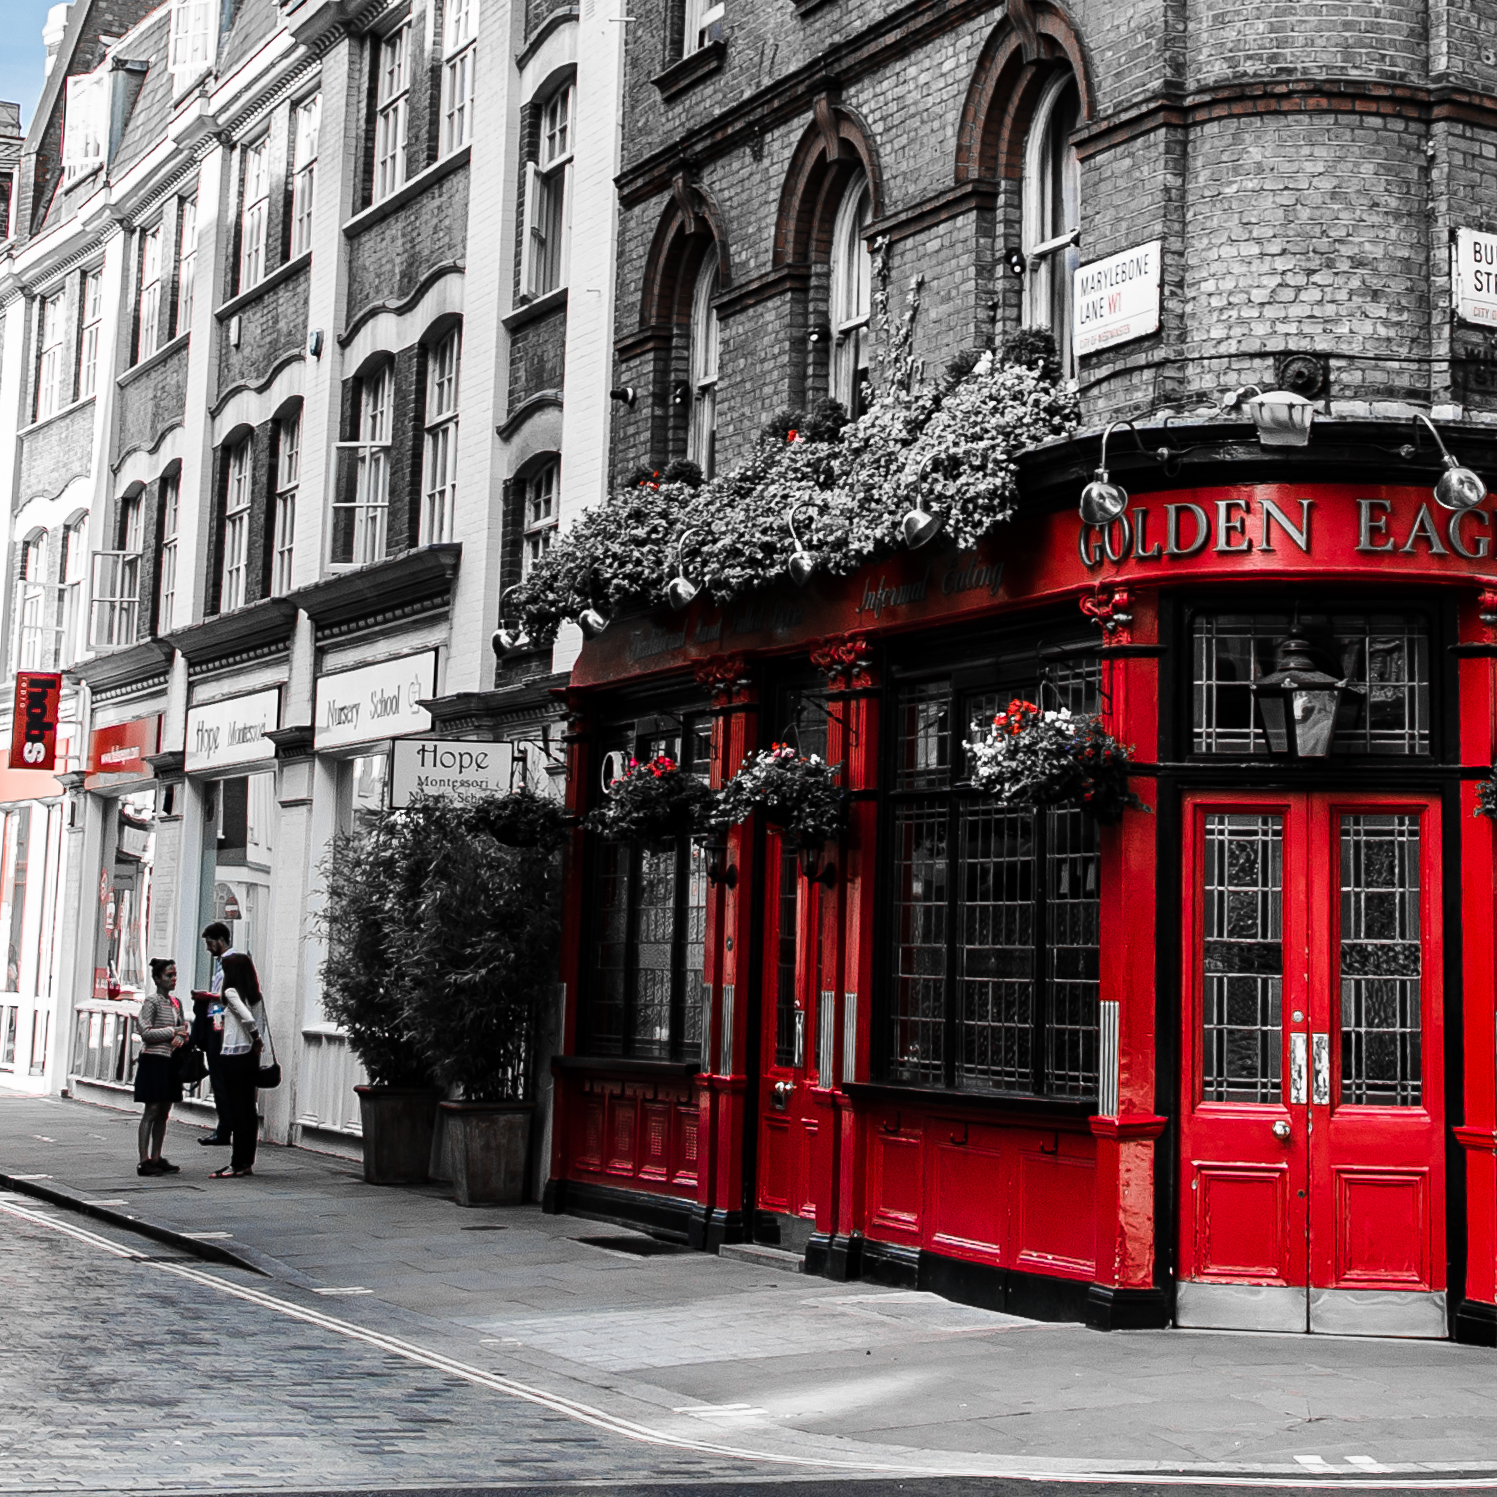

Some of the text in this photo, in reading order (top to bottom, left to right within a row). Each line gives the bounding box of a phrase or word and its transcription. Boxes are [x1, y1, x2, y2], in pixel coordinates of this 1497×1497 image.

[1081, 253, 1149, 298] MARYLEBONE
[1080, 291, 1121, 324] LANE W1
[1473, 306, 1489, 318] CITY
[1078, 498, 1314, 569] GOLDEN
[855, 564, 933, 619] Informal
[942, 556, 1005, 595] Eating
[22, 678, 57, 764] hobs
[327, 684, 401, 730] Nursery School
[196, 720, 221, 760] Hope
[417, 744, 490, 775] Hope
[416, 775, 489, 788] Montessori
